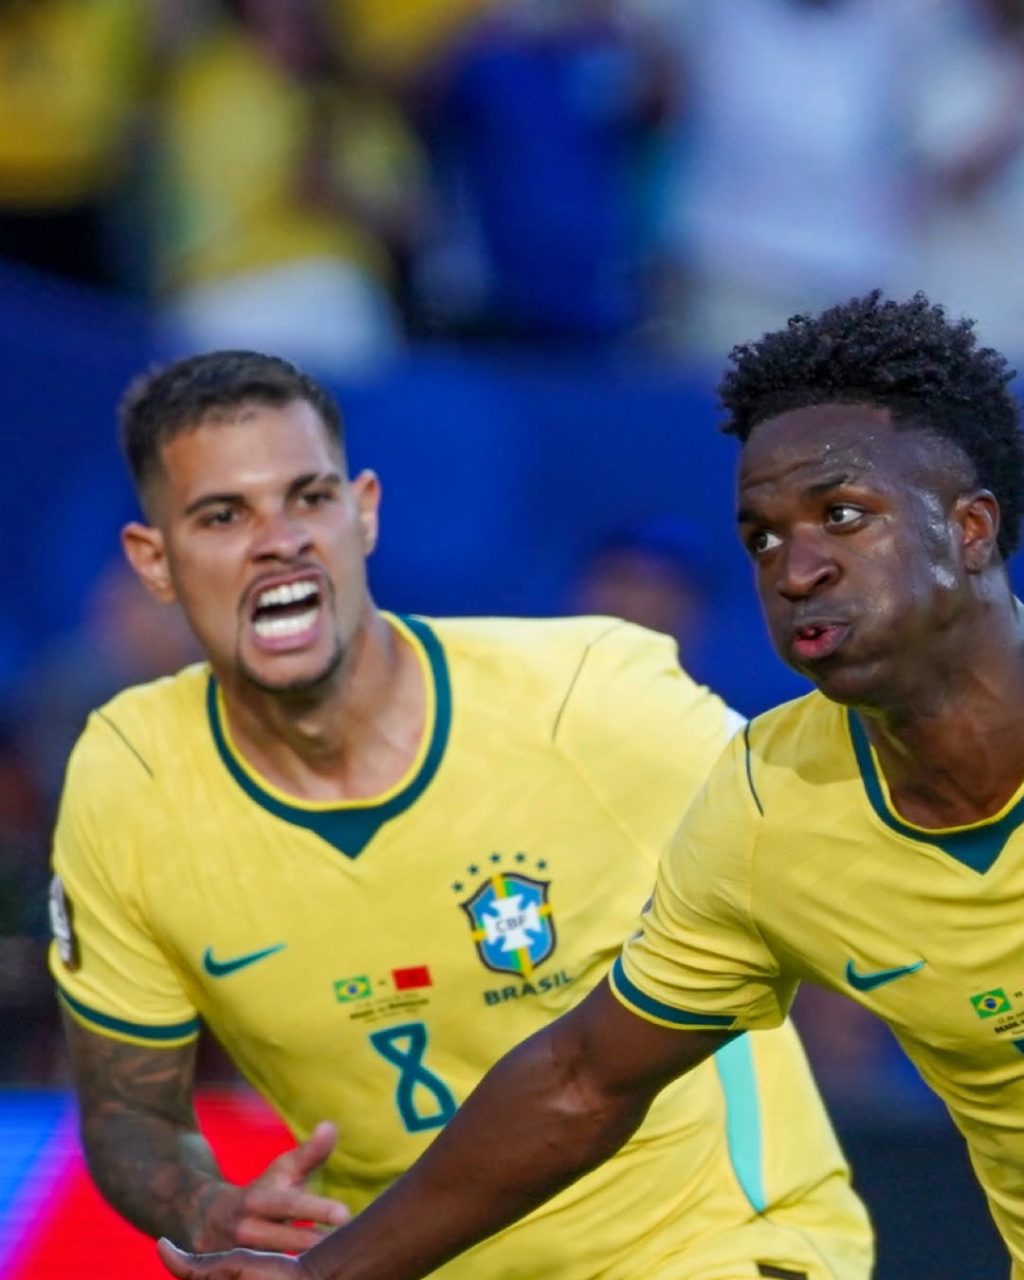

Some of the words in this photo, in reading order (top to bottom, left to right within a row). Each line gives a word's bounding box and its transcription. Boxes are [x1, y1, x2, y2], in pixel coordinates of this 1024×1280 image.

[495, 914, 526, 934] CBF
[483, 970, 573, 1007] BRASIL
[369, 1022, 457, 1132] 8
